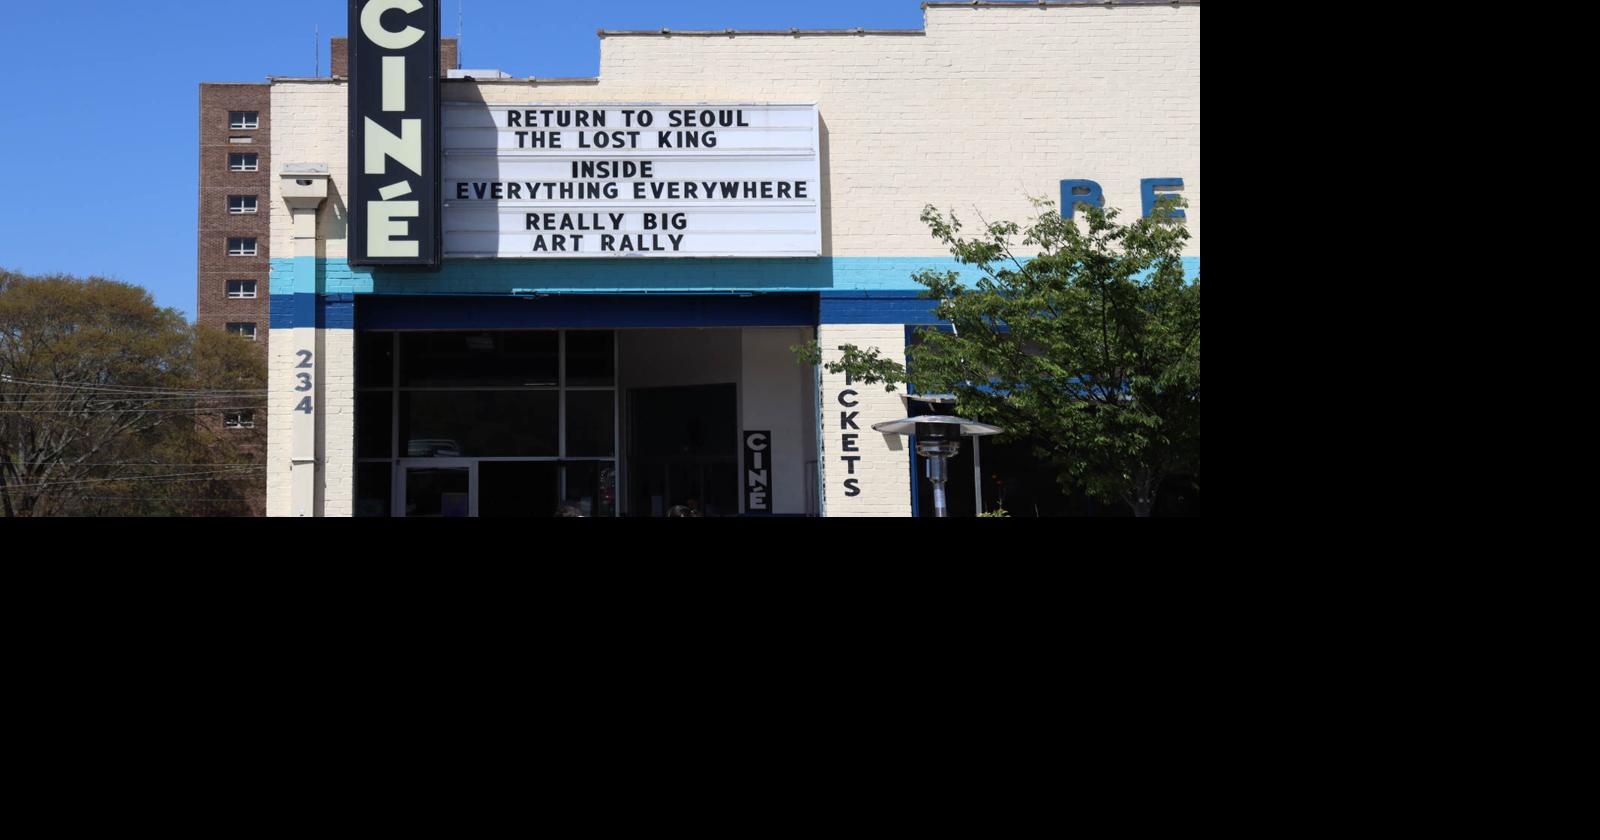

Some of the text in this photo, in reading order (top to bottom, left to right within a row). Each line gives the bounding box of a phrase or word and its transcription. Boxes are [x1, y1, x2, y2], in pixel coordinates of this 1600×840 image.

[508, 110, 748, 127] RETURN TO SEOUL
[361, 0, 425, 257] CINÉ
[516, 131, 716, 148] THE LOST KING
[573, 161, 652, 178] INSIDE
[456, 182, 806, 199] EVERYTHING EVERYWHERE
[527, 213, 686, 229] REALLY BIG
[534, 235, 682, 250] ART RALLY
[294, 349, 313, 415] 234
[746, 432, 768, 510] CINÉ
